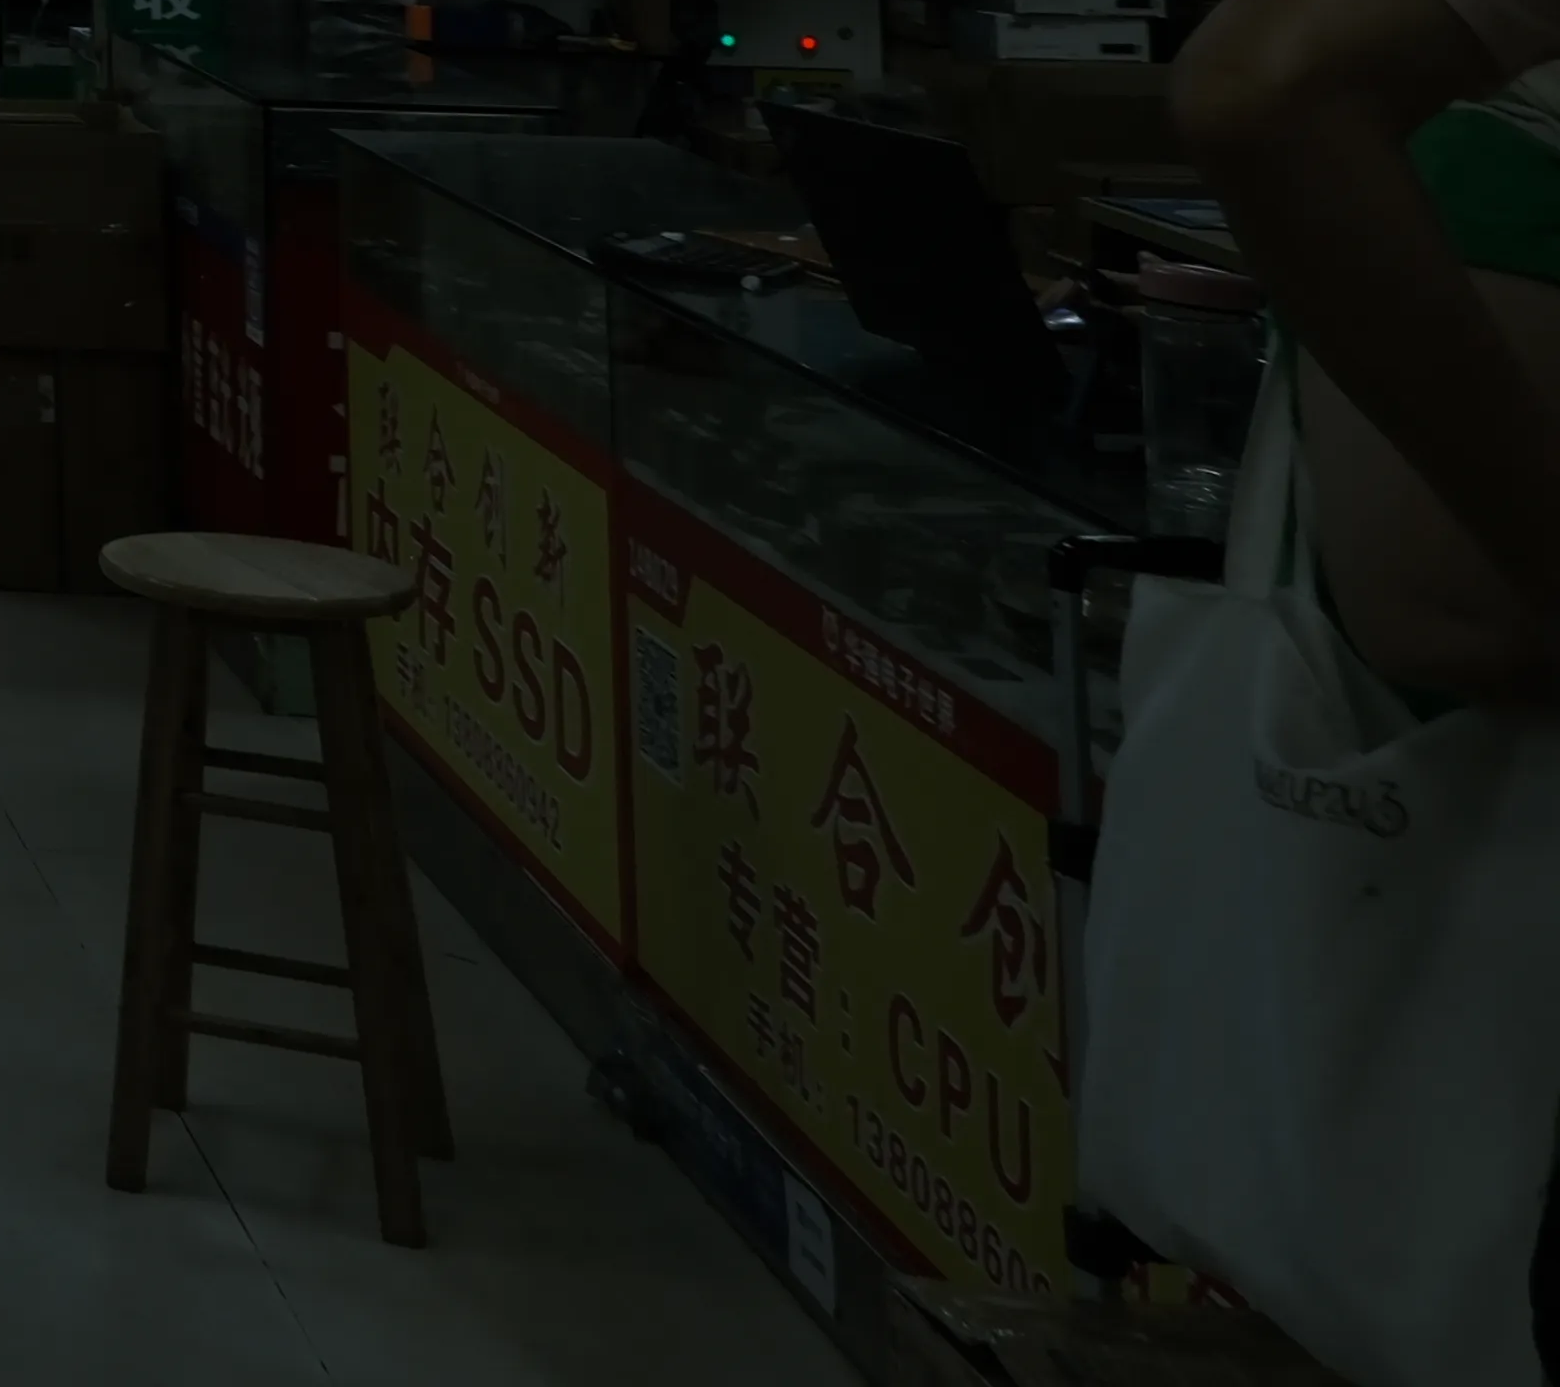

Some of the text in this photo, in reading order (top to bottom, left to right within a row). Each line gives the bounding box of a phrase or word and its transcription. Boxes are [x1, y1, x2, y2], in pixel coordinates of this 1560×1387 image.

[376, 379, 571, 611] 联合创新
[366, 475, 594, 784] 内存 SSD
[888, 990, 1034, 1208] CPU
